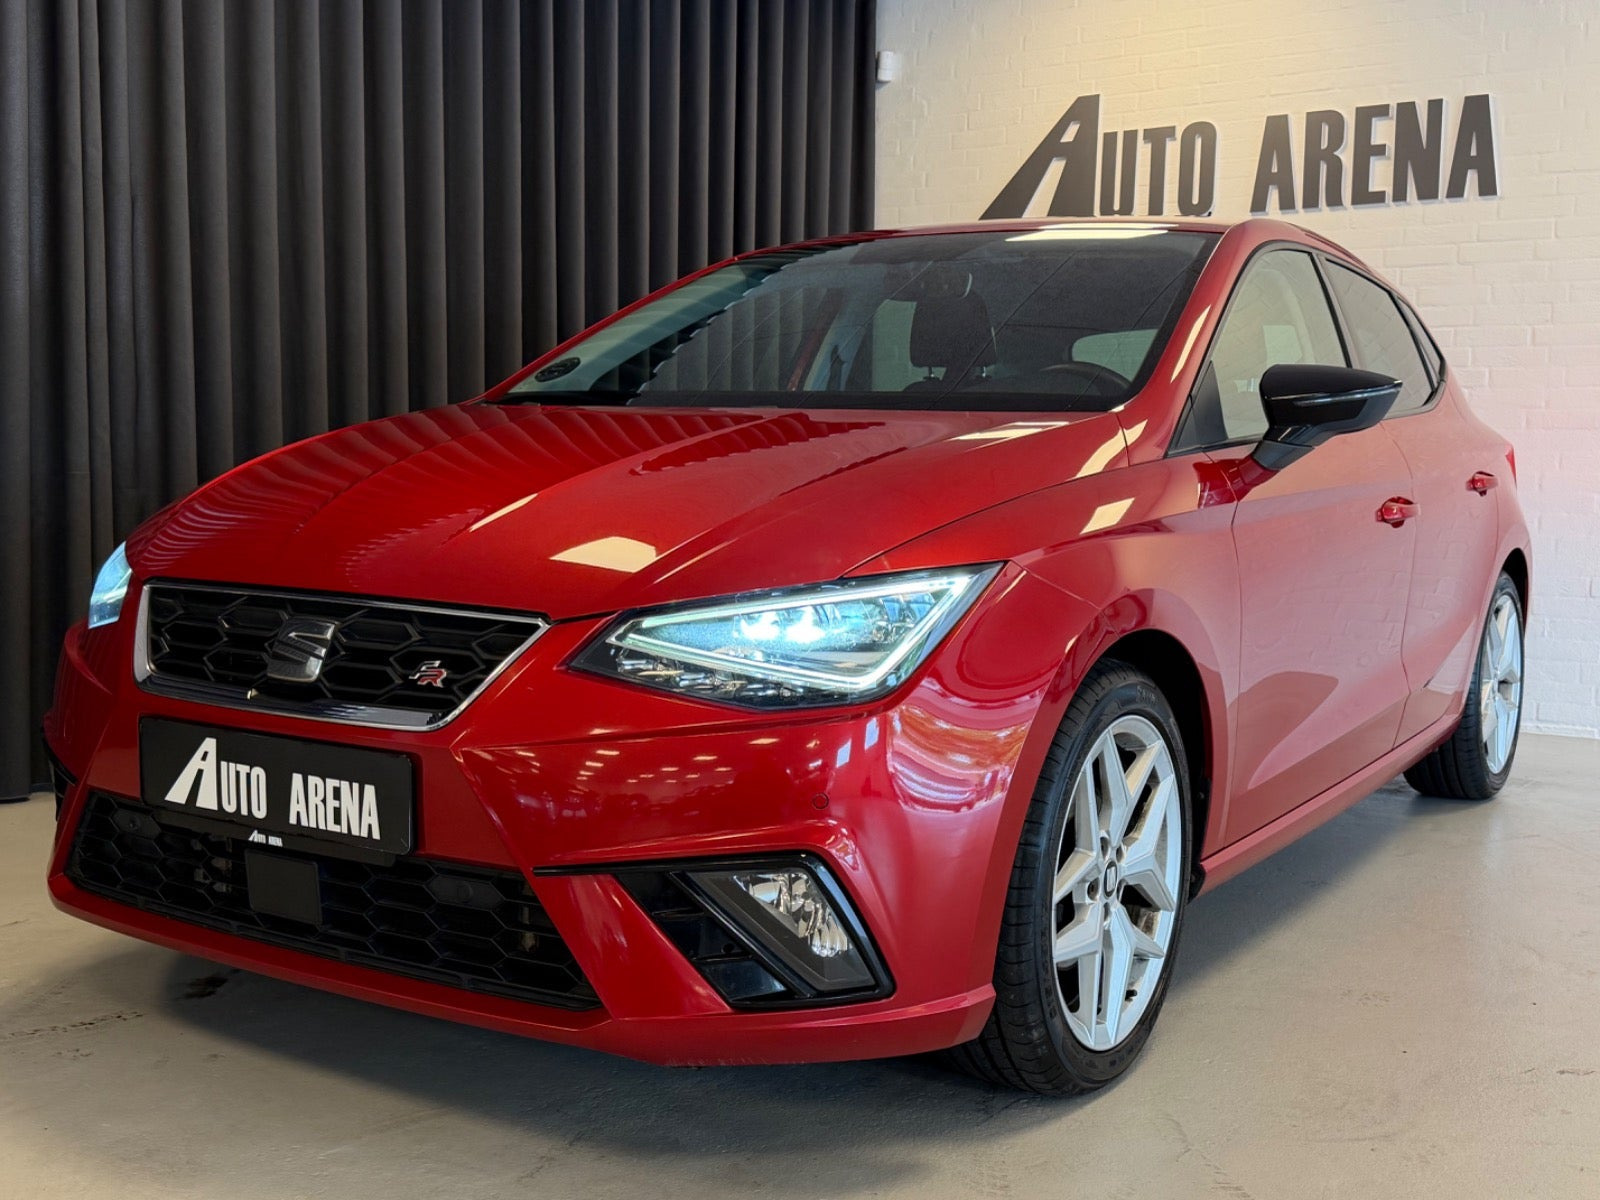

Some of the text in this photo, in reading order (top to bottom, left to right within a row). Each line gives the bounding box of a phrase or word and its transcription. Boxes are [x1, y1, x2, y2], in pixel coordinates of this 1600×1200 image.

[978, 93, 1499, 219] AUTO ARENA
[164, 737, 381, 840] AUTO ARENA
